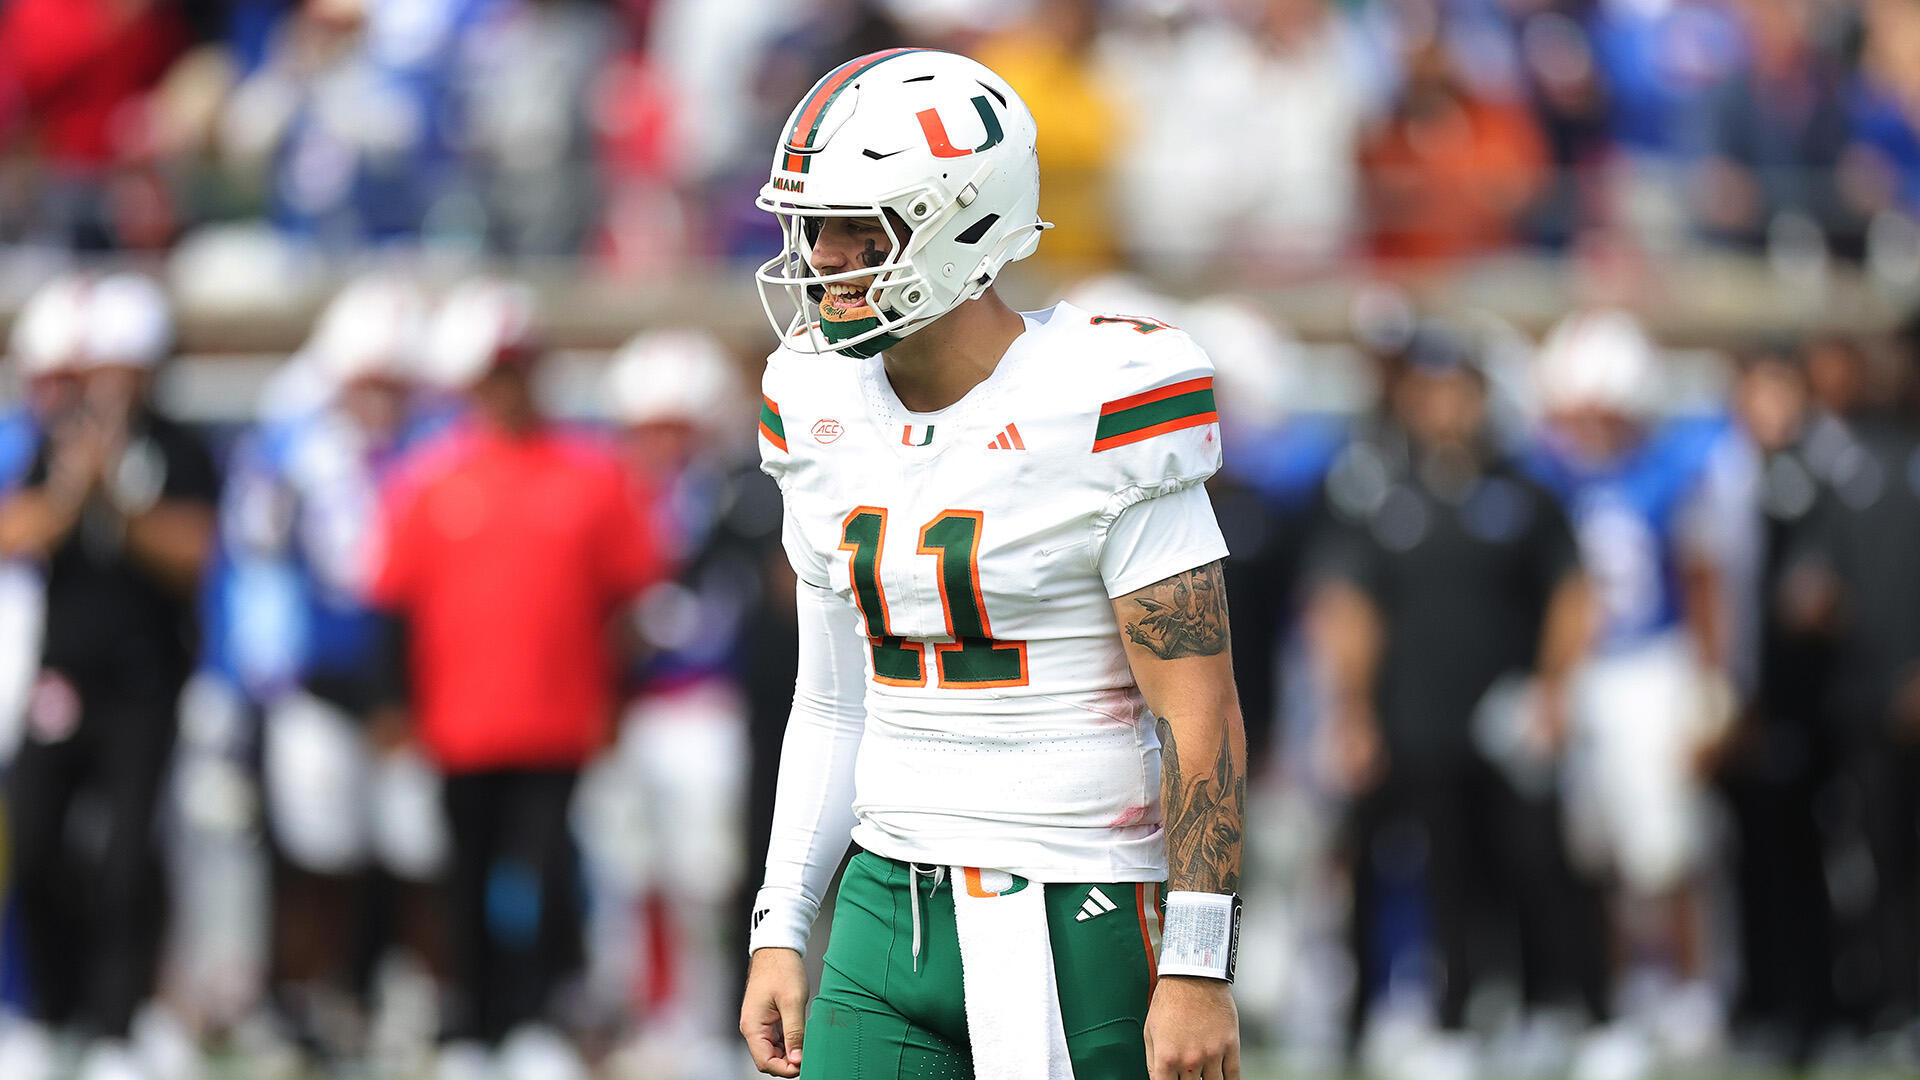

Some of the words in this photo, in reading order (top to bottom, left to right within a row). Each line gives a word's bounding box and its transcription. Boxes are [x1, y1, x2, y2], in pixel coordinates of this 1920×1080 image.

[915, 95, 1004, 158] U
[773, 176, 804, 193] MIAMI
[816, 424, 840, 433] ACC
[902, 424, 935, 447] U
[837, 505, 1030, 689] 11
